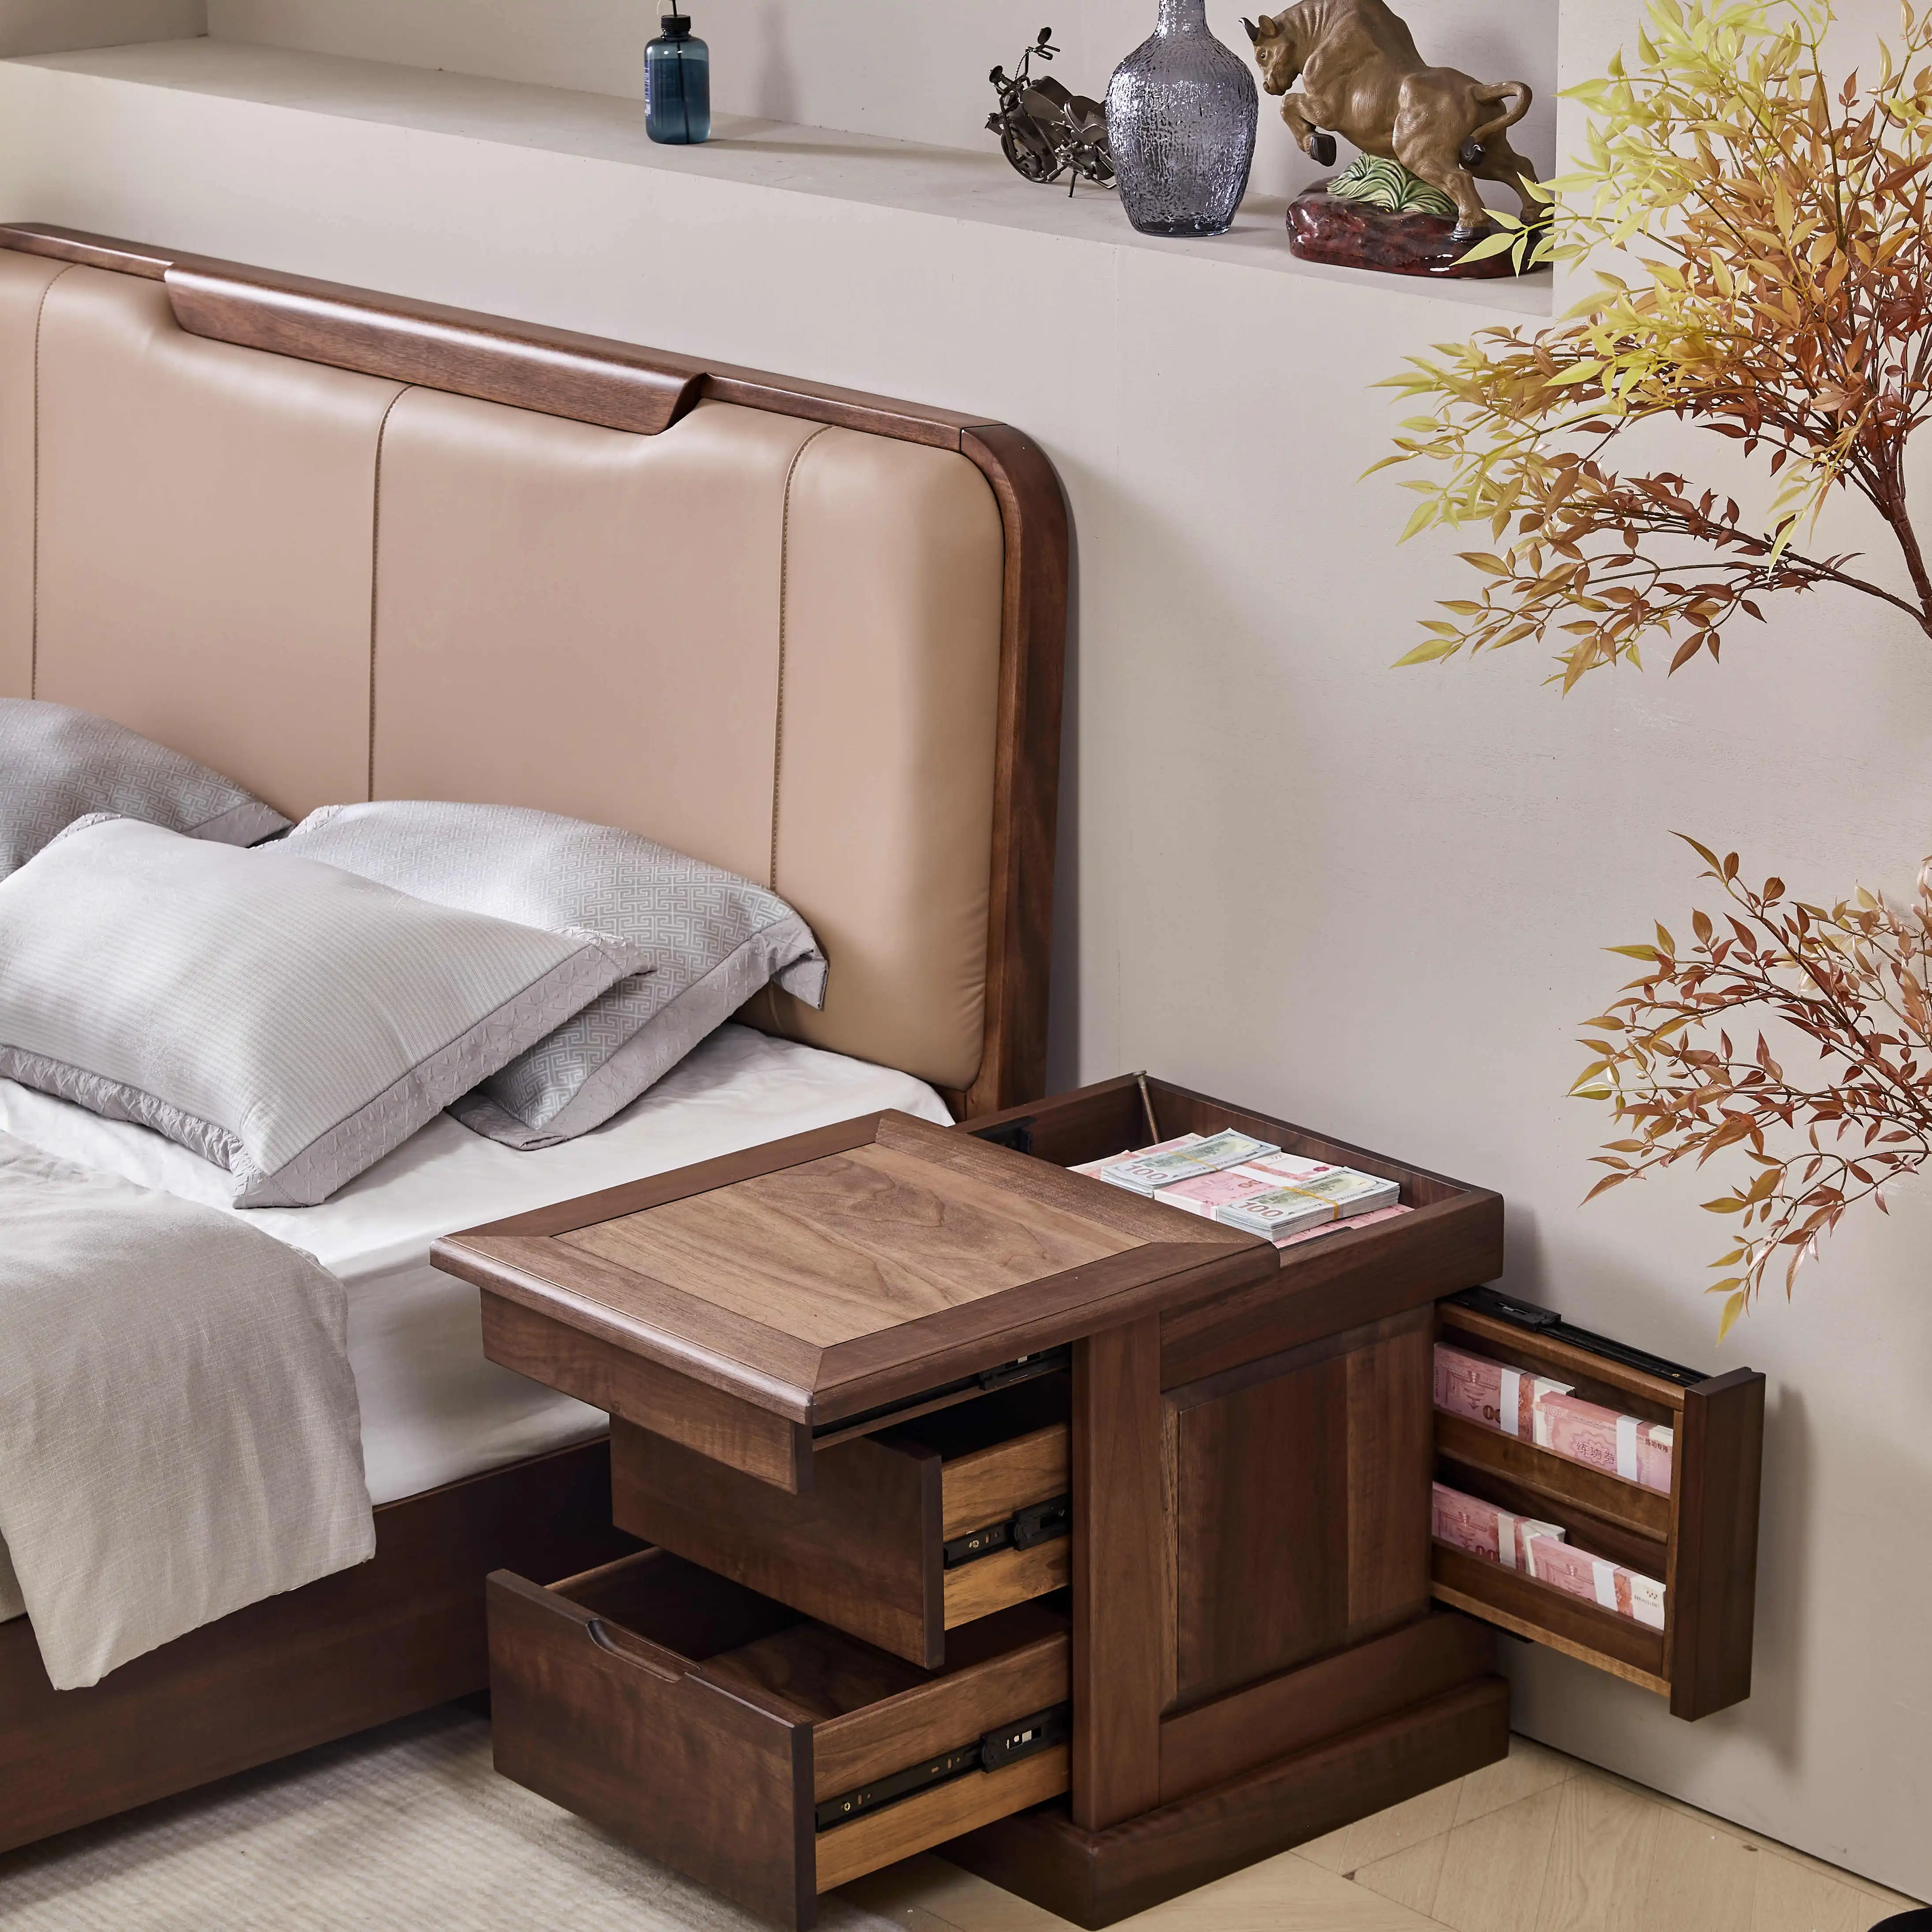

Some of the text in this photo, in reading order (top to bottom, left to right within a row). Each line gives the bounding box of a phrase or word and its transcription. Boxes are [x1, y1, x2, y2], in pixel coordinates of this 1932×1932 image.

[1123, 1164, 1168, 1180] 100
[1238, 1201, 1284, 1217] 100
[1576, 1442, 1615, 1464] 练功券
